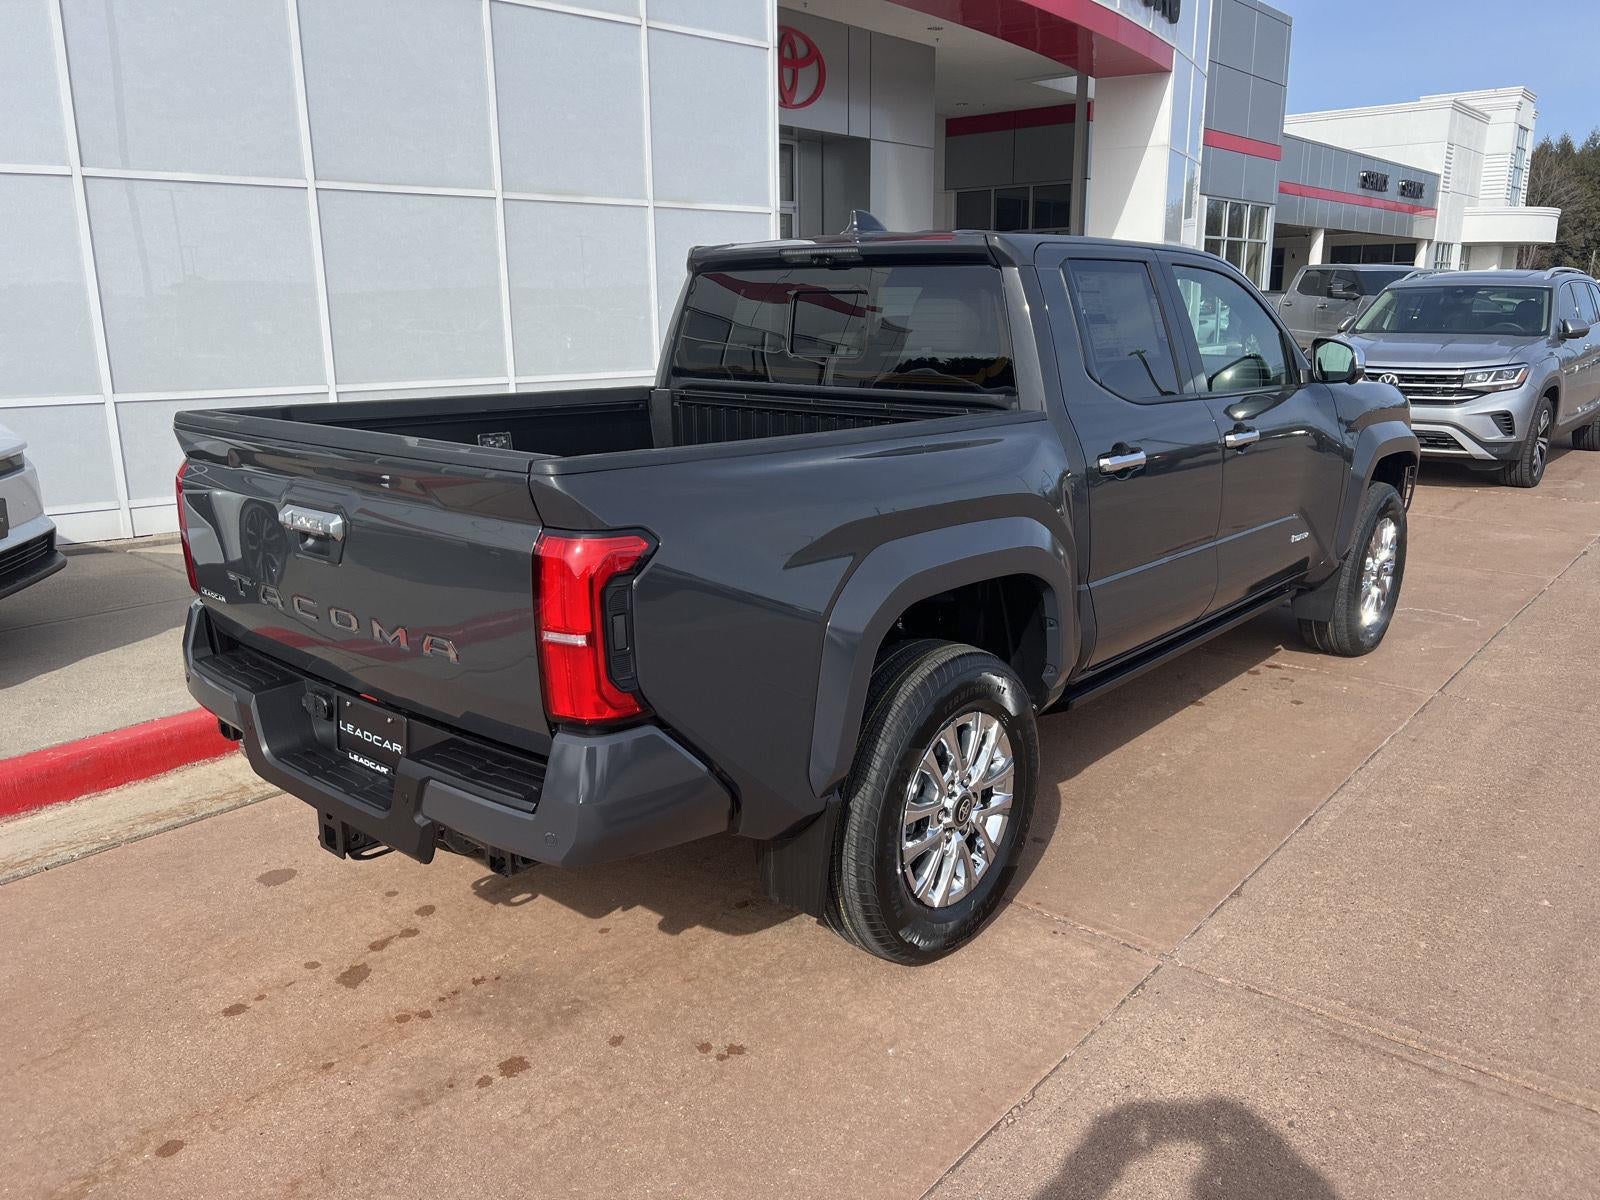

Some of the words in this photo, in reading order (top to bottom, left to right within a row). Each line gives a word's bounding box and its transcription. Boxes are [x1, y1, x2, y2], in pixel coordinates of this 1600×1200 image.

[227, 571, 460, 664] TACOMA
[339, 720, 402, 755] LEADCAR
[348, 752, 389, 775] LEADCAR
